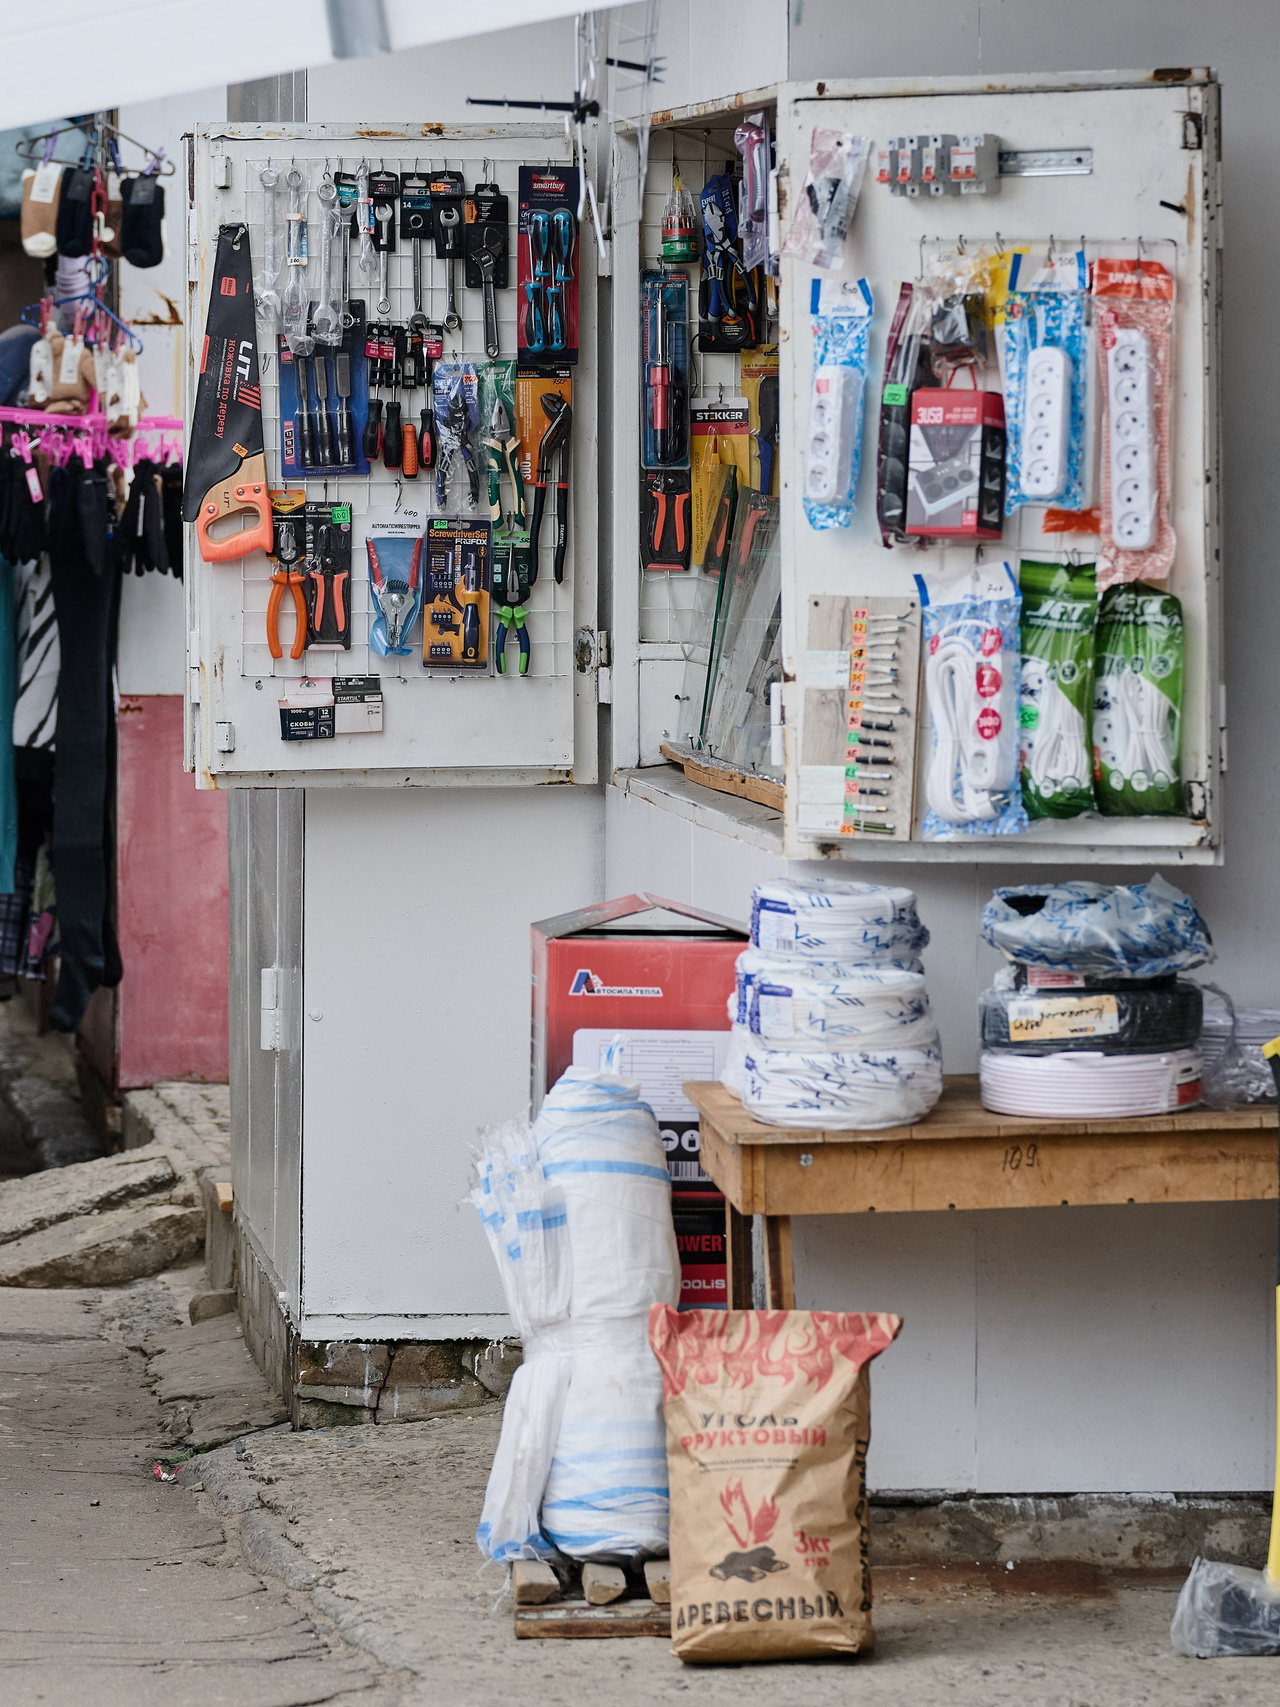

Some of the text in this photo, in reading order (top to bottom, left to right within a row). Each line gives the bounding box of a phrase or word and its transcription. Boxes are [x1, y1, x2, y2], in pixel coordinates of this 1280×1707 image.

[533, 181, 564, 190] smartbuy
[237, 339, 254, 381] LIT
[214, 339, 236, 439] ножовка по дереву
[696, 411, 743, 420] STEKKER
[521, 461, 532, 480] 300
[403, 509, 418, 517] 400
[429, 529, 488, 539] ScrewdriverSet
[981, 669, 992, 686] 7
[571, 971, 633, 995] АВТОСИЛА
[1002, 1143, 1038, 1173] 109
[676, 1234, 723, 1252] OWER
[681, 1278, 726, 1290] OOLiS
[700, 1411, 799, 1429] УГОЛЬ
[681, 1424, 827, 1452] ФРУКТОВЫЙ
[794, 1529, 832, 1554] 3кг
[676, 1590, 844, 1631] ДРЕВЕСНЫЙ
